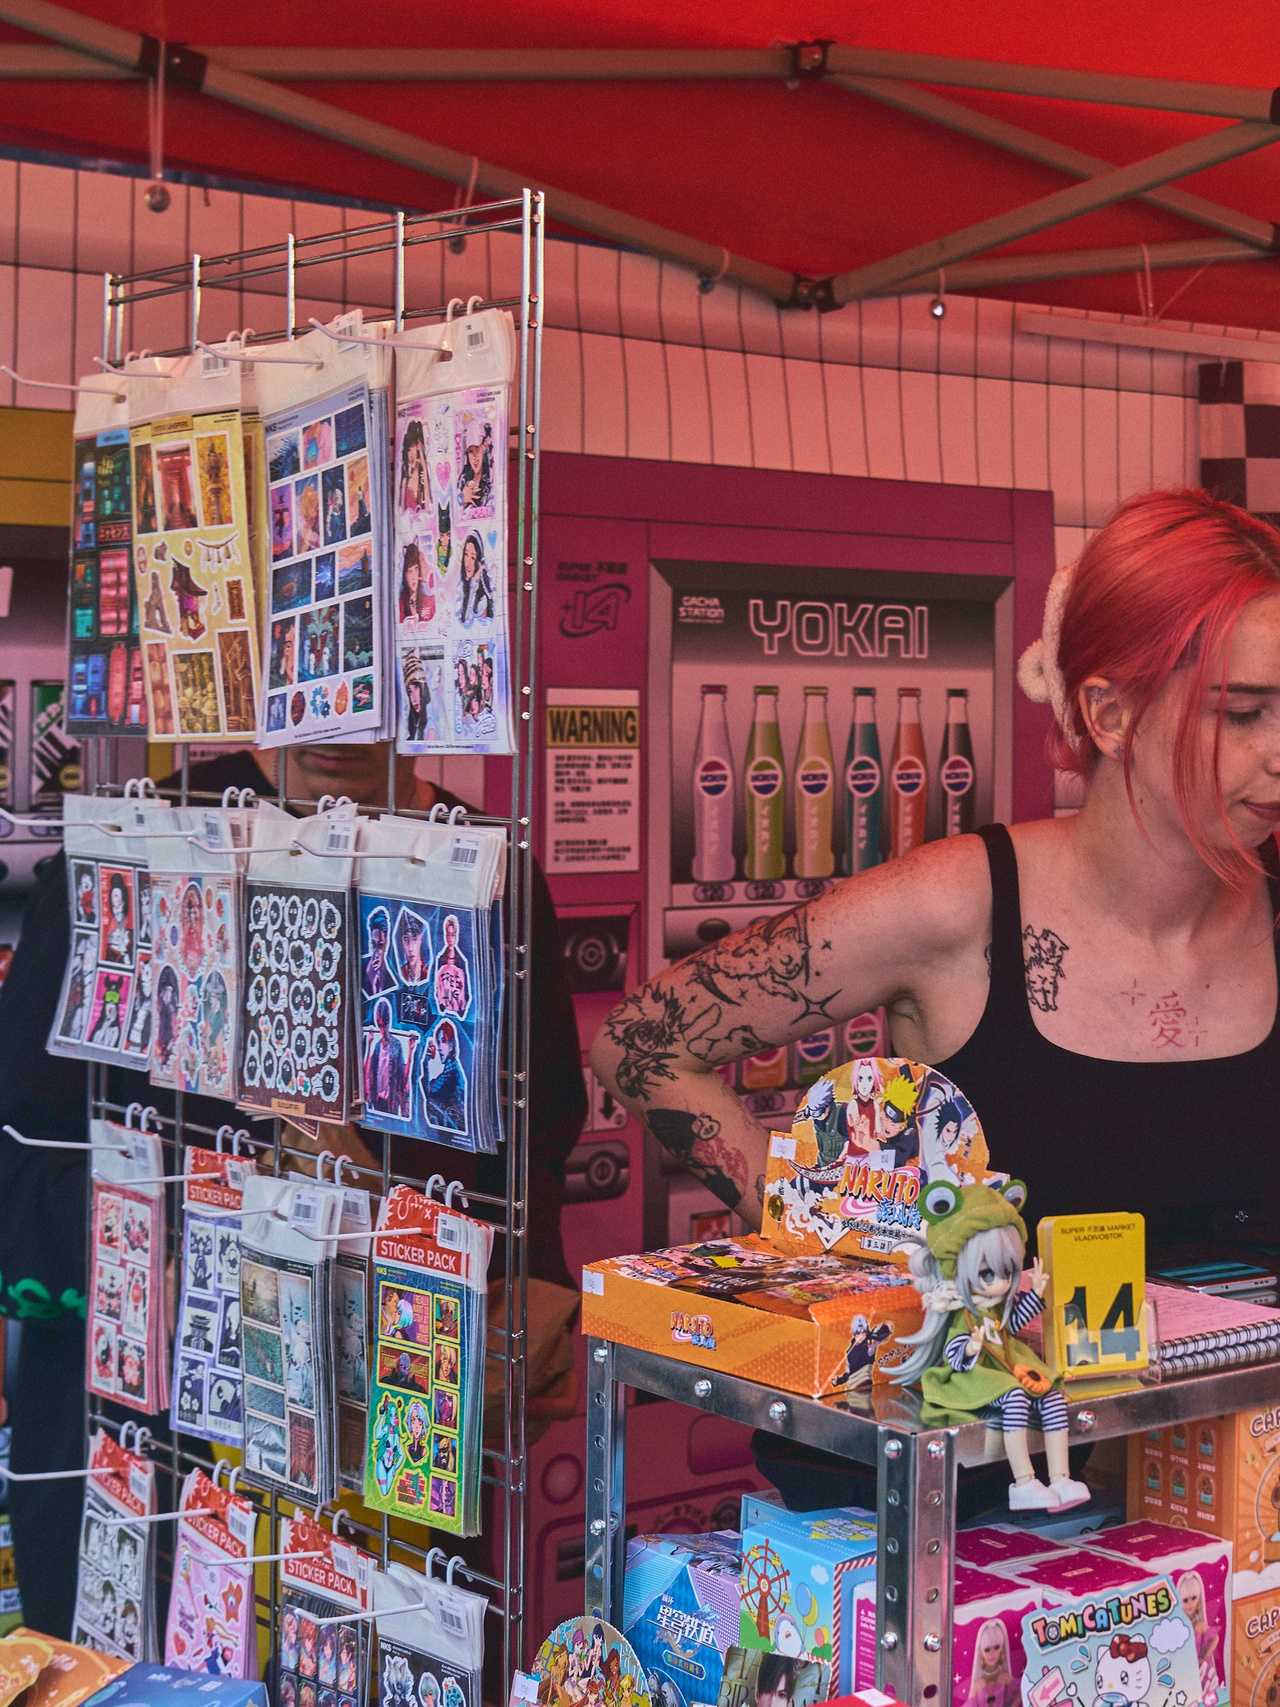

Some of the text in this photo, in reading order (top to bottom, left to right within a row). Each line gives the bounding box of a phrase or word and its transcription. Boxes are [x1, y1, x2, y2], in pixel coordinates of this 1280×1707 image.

[678, 606, 726, 619] STATION
[682, 596, 720, 607] GACHA
[748, 599, 930, 659] YOKAI
[549, 709, 637, 744] WARNING
[1149, 991, 1187, 1050] 愛
[189, 1184, 242, 1210] STICKER PAC
[839, 1161, 921, 1206] NARUTO
[1060, 1226, 1085, 1235] SUPER
[1107, 1222, 1136, 1231] MARKET
[1074, 1232, 1124, 1242] VLADIVOSTOK
[380, 1239, 457, 1273] STICKER PACK
[670, 1310, 713, 1337] NARUTO
[1063, 1282, 1142, 1367] 14
[219, 1532, 248, 1561] PACK
[288, 1558, 353, 1596] STICKER PACK
[379, 1641, 391, 1652] NKS
